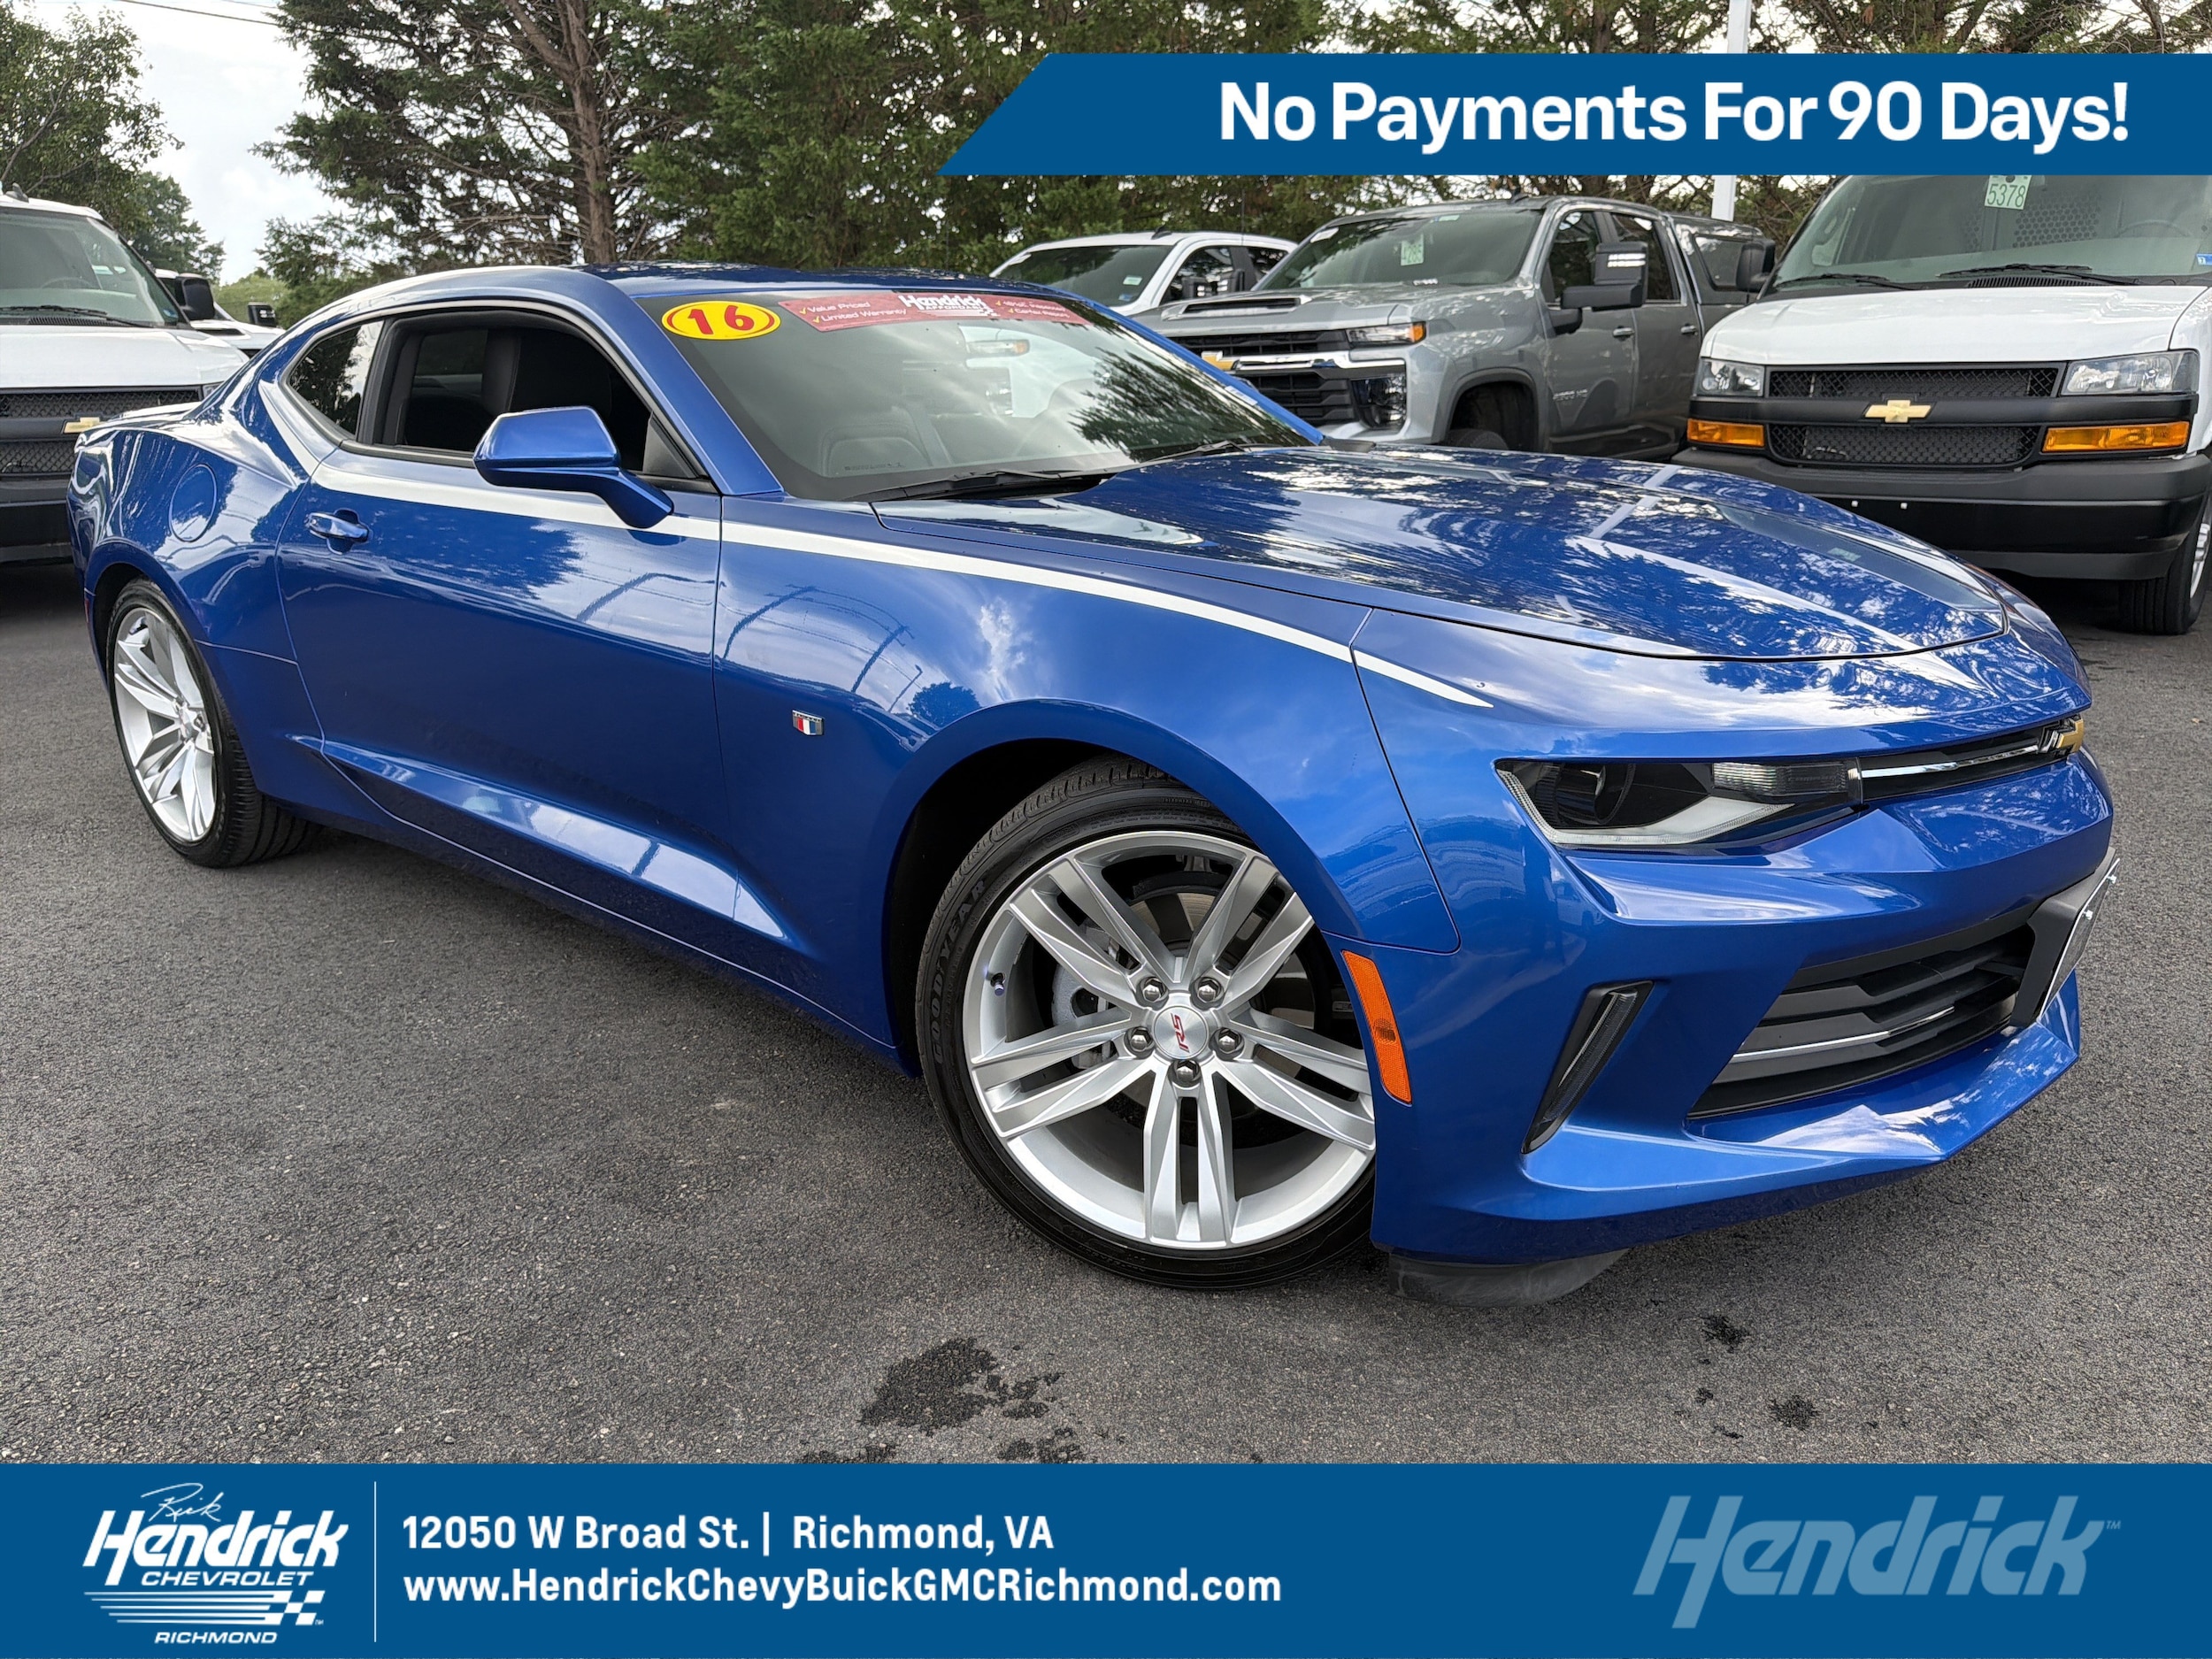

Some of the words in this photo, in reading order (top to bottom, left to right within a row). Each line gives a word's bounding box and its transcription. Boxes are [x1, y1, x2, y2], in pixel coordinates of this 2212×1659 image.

[1986, 182, 2026, 208] 5378
[807, 304, 837, 313] Value
[837, 301, 872, 310] Priced
[897, 295, 989, 311] Hendrick
[687, 304, 756, 335] 16
[820, 311, 860, 322] Limited
[931, 879, 985, 1064] GOODYEAR
[1171, 1013, 1190, 1053] RS
